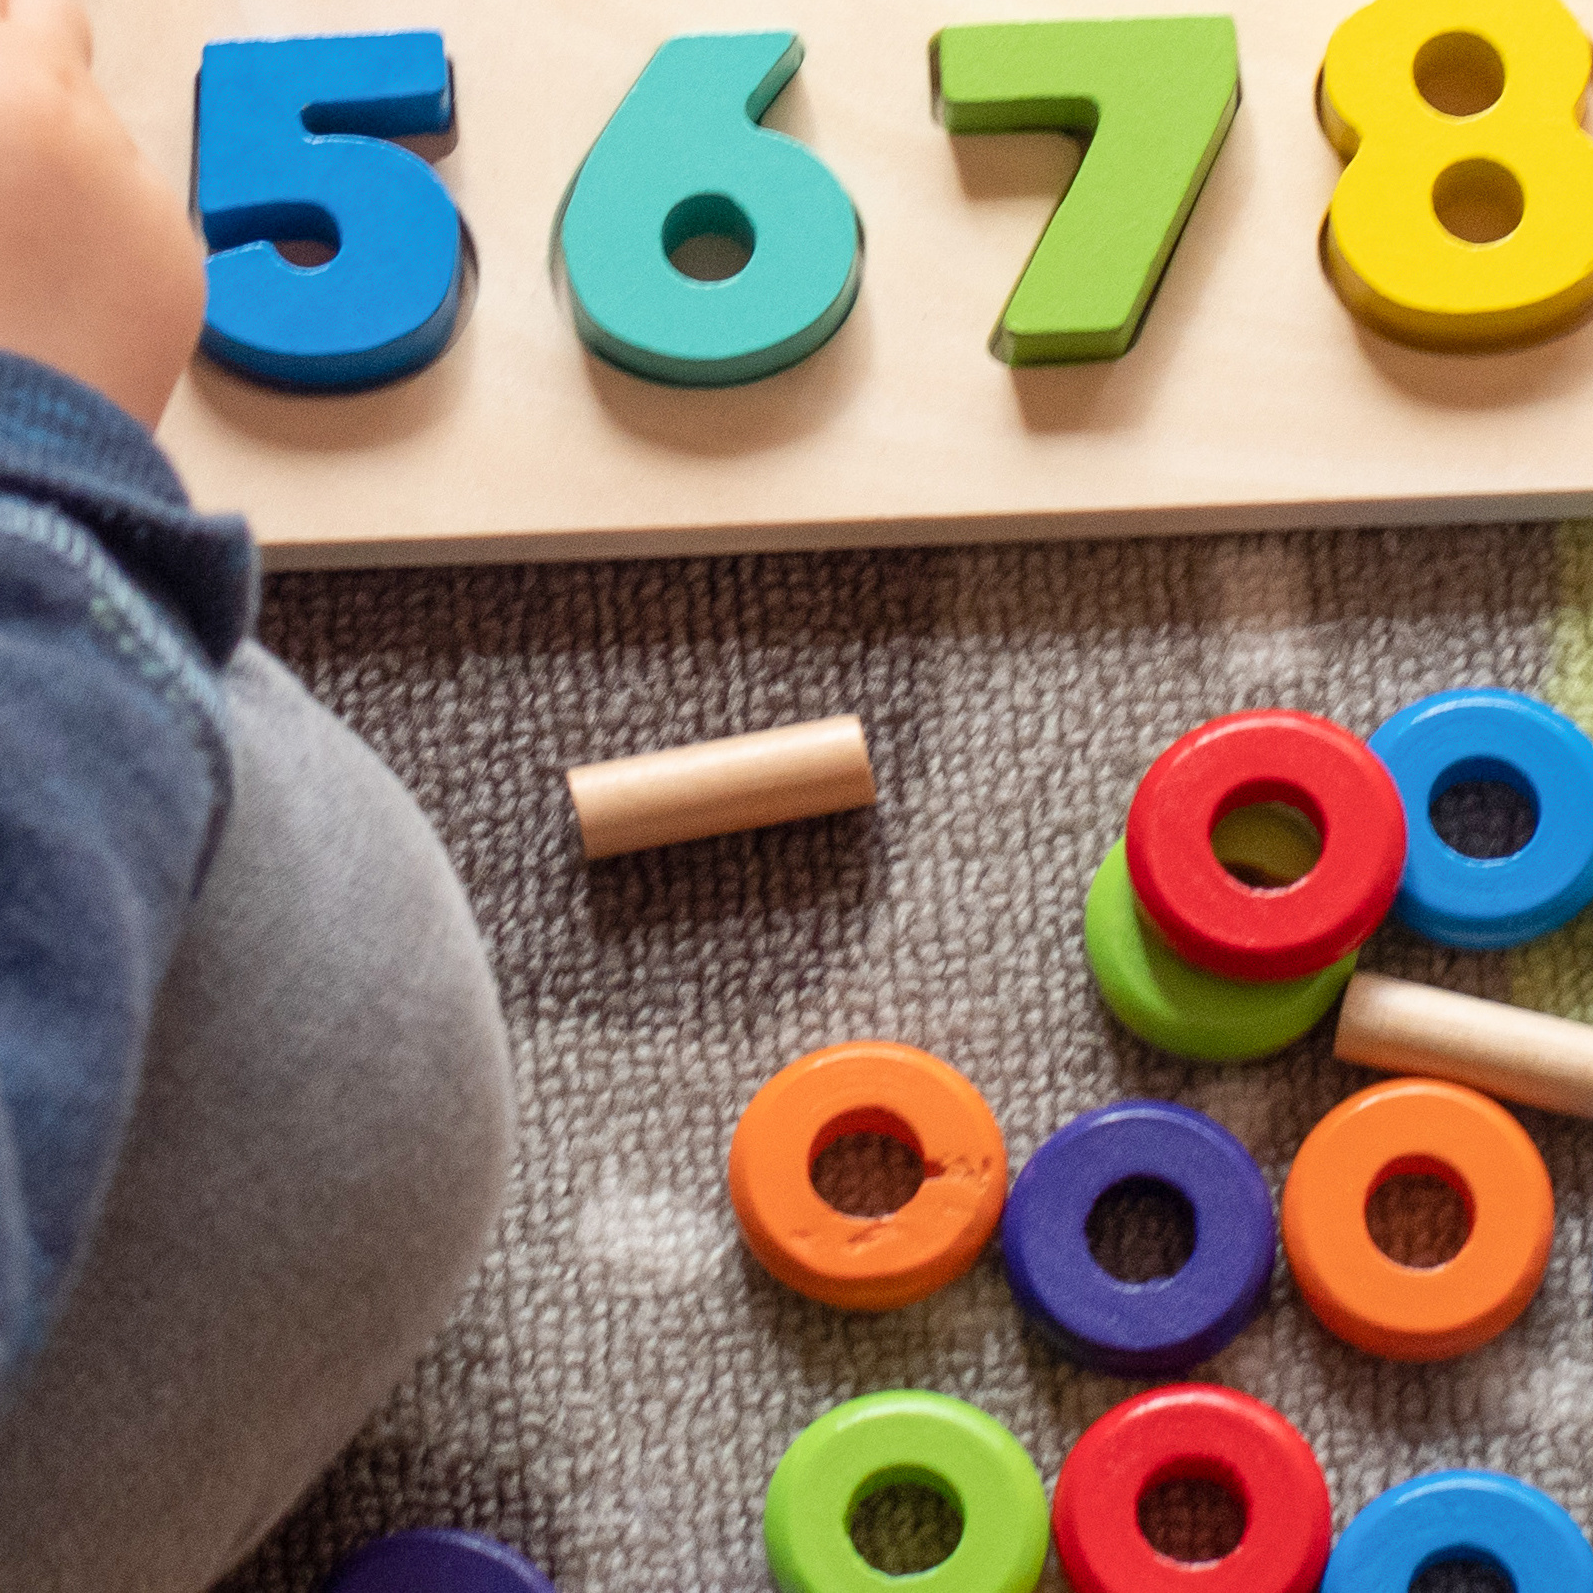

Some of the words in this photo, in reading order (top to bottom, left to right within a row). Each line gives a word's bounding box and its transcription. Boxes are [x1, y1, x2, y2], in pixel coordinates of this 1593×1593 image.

[196, 30, 462, 390] 5
[560, 30, 861, 387] 6
[936, 14, 1239, 366] 7
